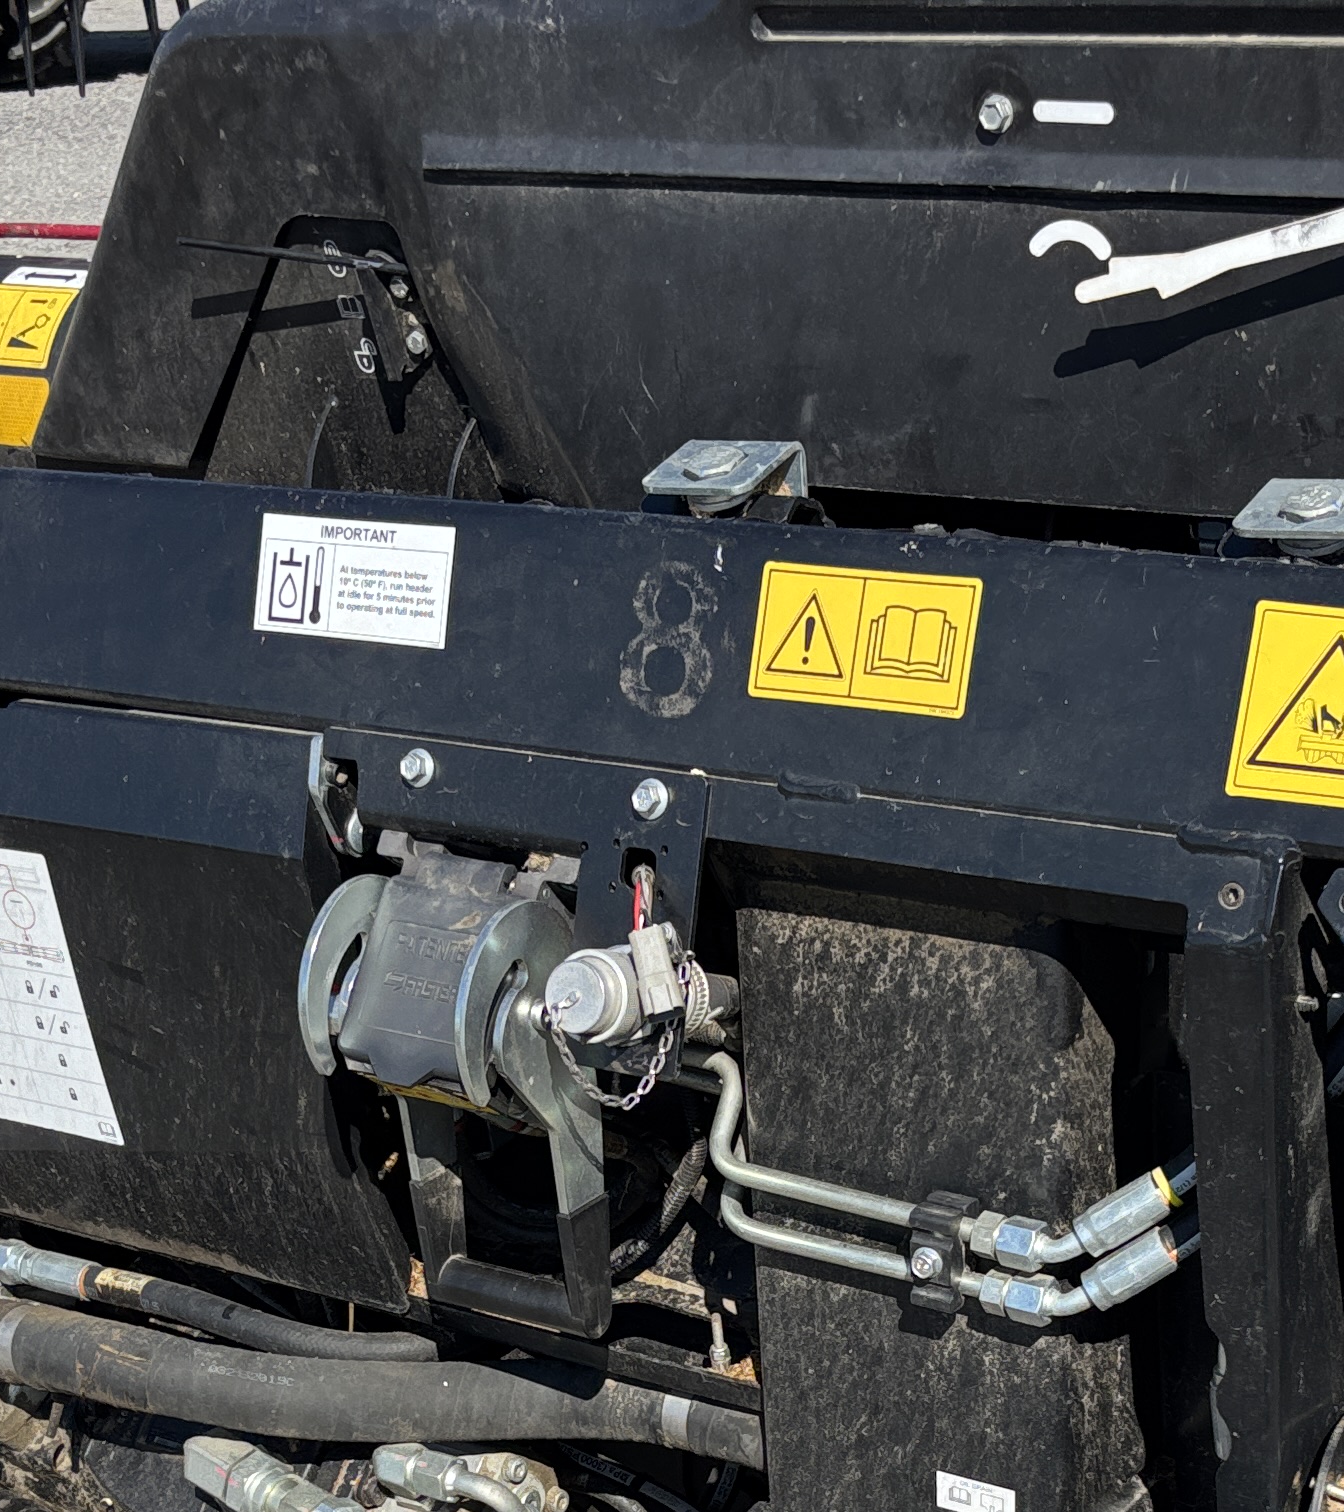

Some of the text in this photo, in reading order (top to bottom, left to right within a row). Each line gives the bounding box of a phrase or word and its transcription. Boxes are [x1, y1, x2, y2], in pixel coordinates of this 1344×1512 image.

[321, 525, 397, 543] IMPORTANT
[340, 565, 428, 580] At temperatures below
[353, 578, 359, 587] C
[390, 583, 404, 591] run
[406, 583, 433, 593] header
[338, 590, 435, 606] at idle for 5 minutes prior
[346, 604, 383, 615] operating
[395, 606, 407, 615] full
[409, 609, 435, 618] speed.
[620, 560, 718, 718] 8
[396, 931, 469, 964] PATENTE
